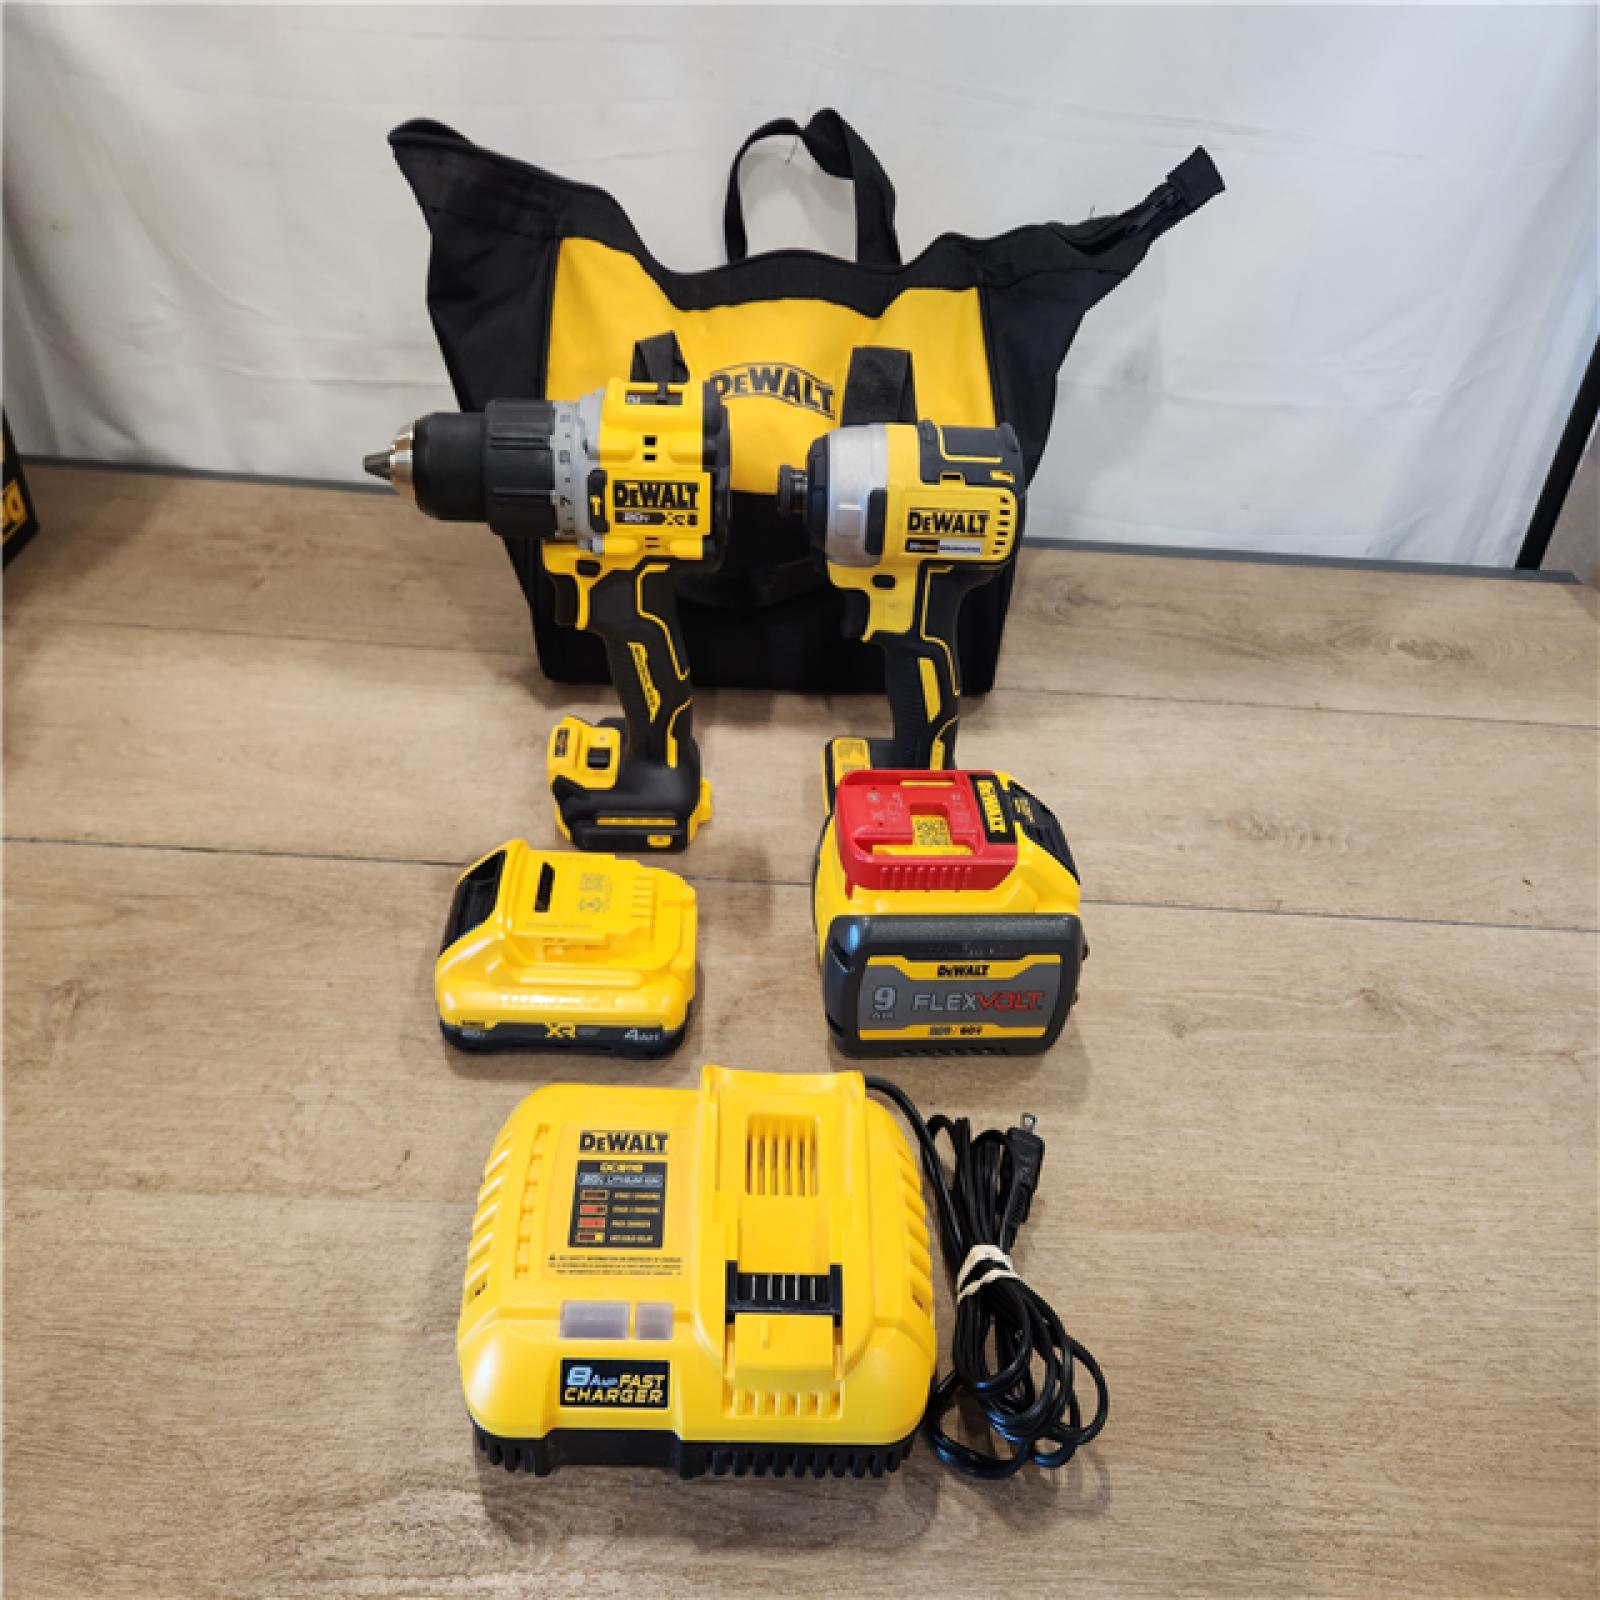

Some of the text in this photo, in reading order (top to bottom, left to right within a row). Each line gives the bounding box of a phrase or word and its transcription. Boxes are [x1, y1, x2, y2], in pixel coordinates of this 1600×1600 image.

[873, 986, 1045, 1012] 9 FLEXVOLT
[580, 1132, 668, 1153] DEWALT
[619, 1373, 666, 1390] FAST
[564, 1387, 664, 1404] CHARGER
